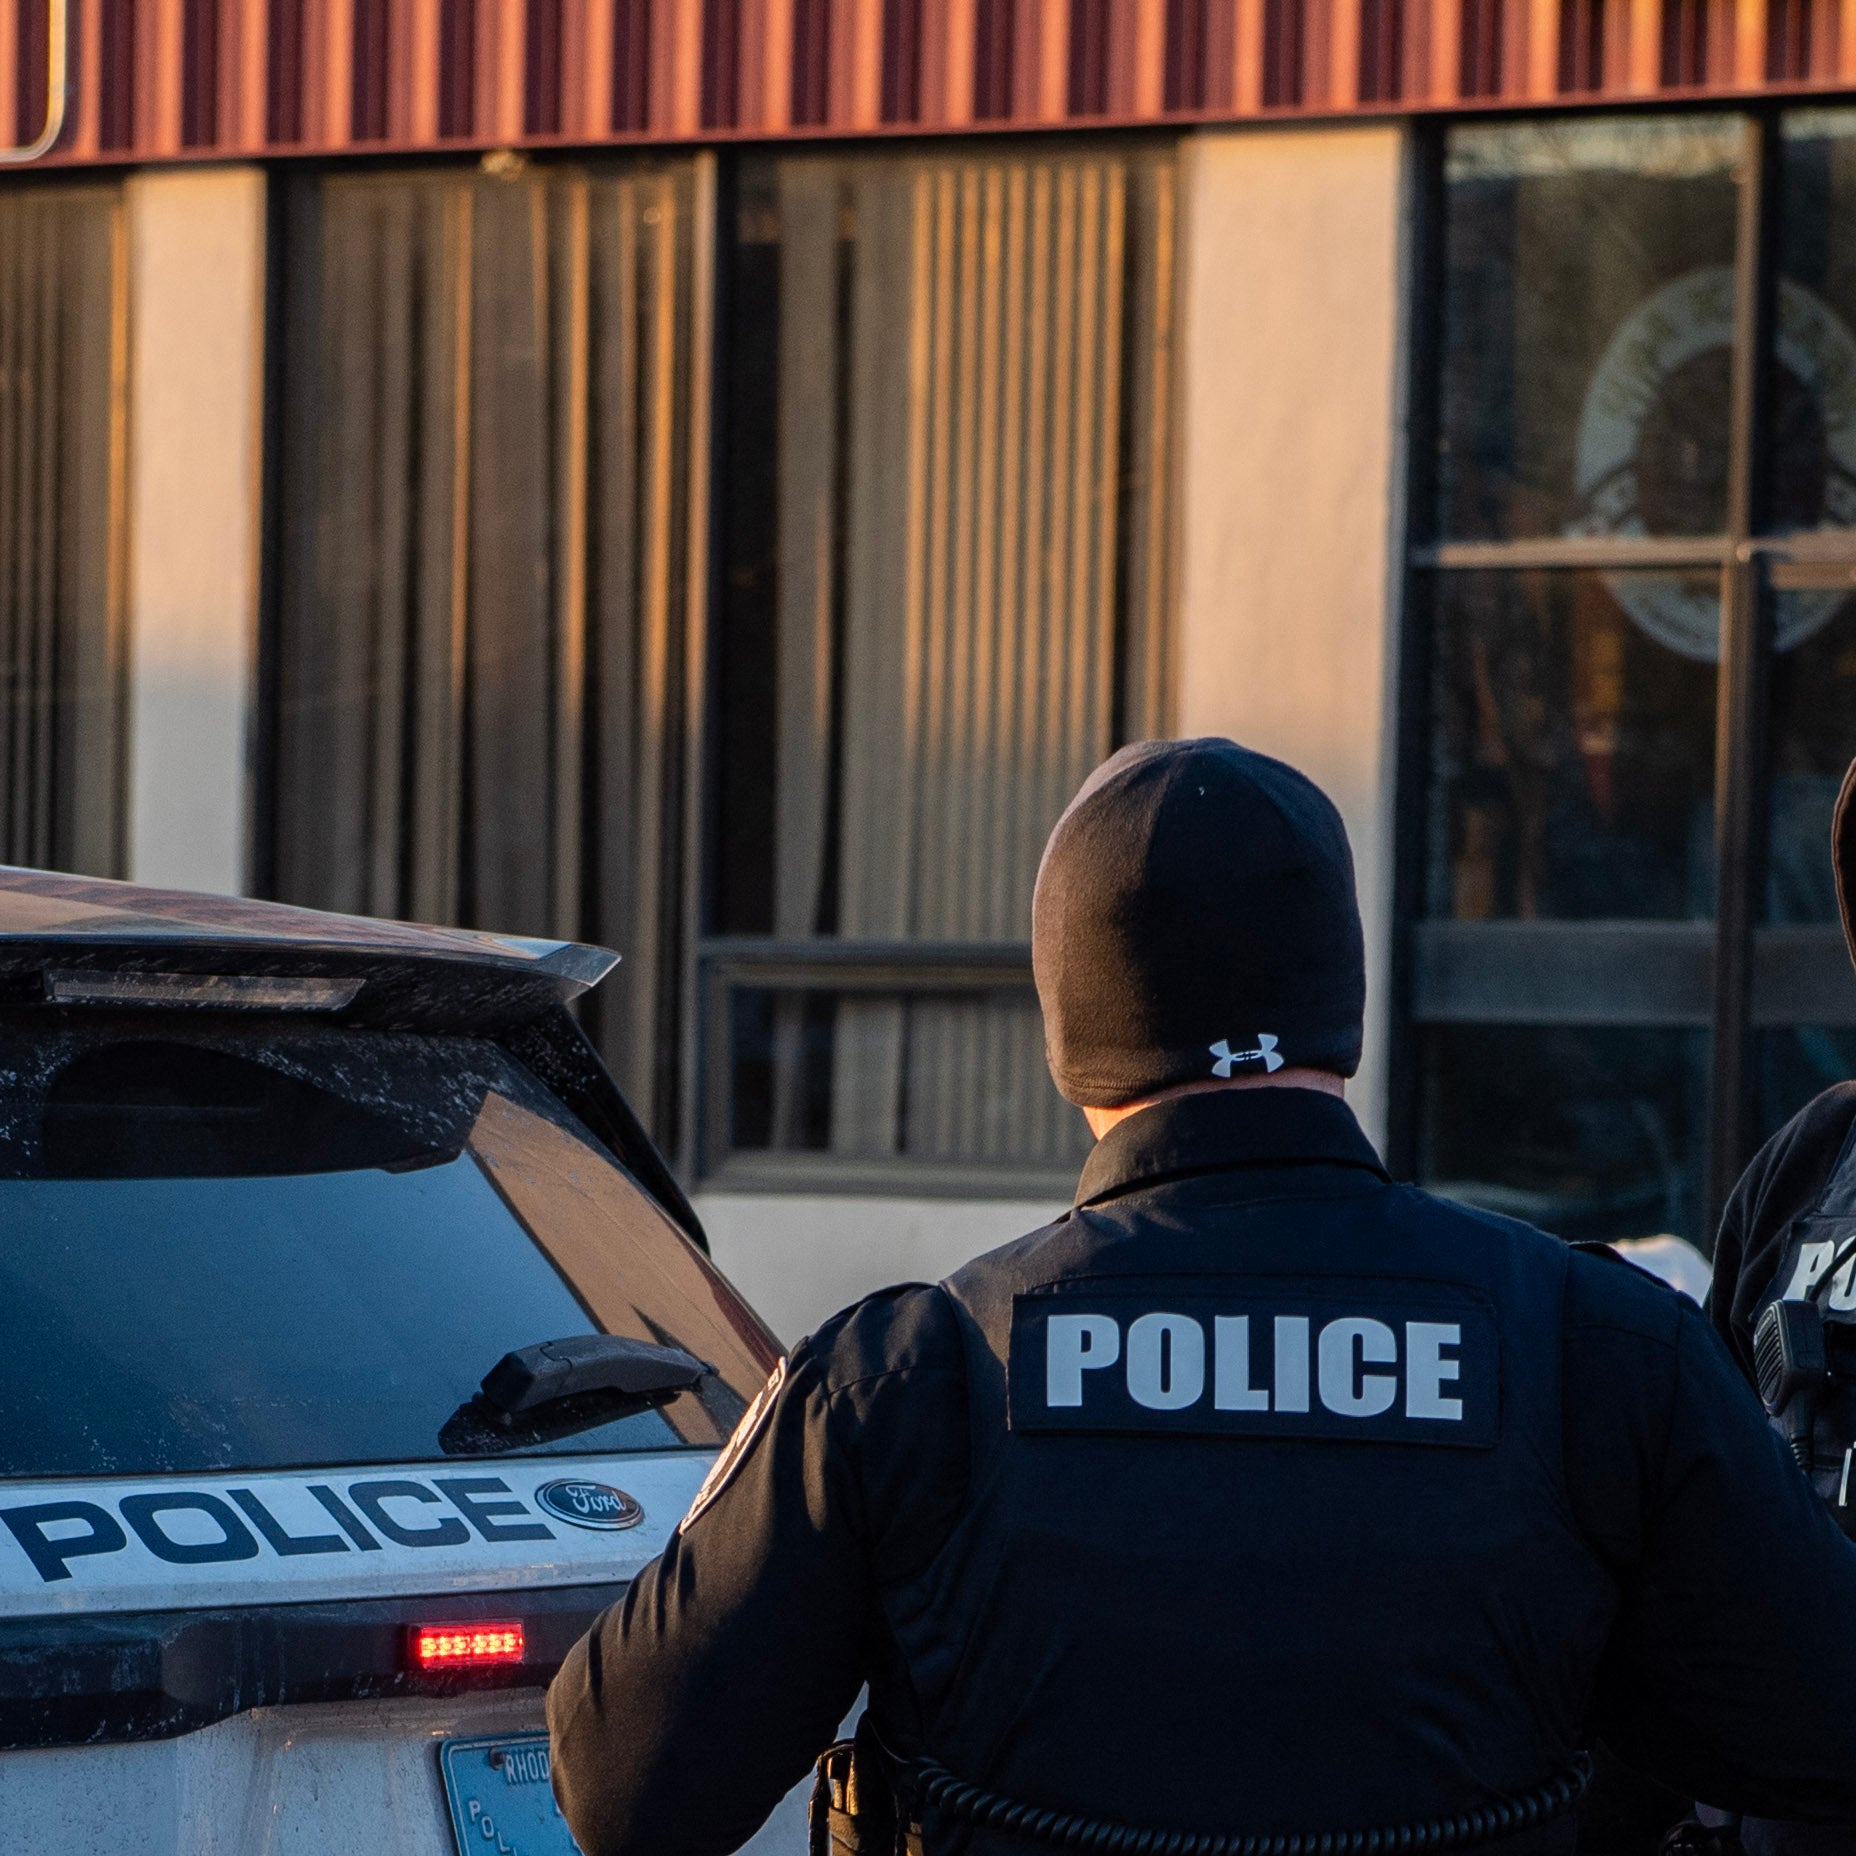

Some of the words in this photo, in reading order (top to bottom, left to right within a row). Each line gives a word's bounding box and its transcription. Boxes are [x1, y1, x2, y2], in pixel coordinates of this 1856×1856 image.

[1047, 1312, 1463, 1421] POLICE
[565, 1485, 627, 1514] Ford
[505, 1749, 551, 1786] RHOD
